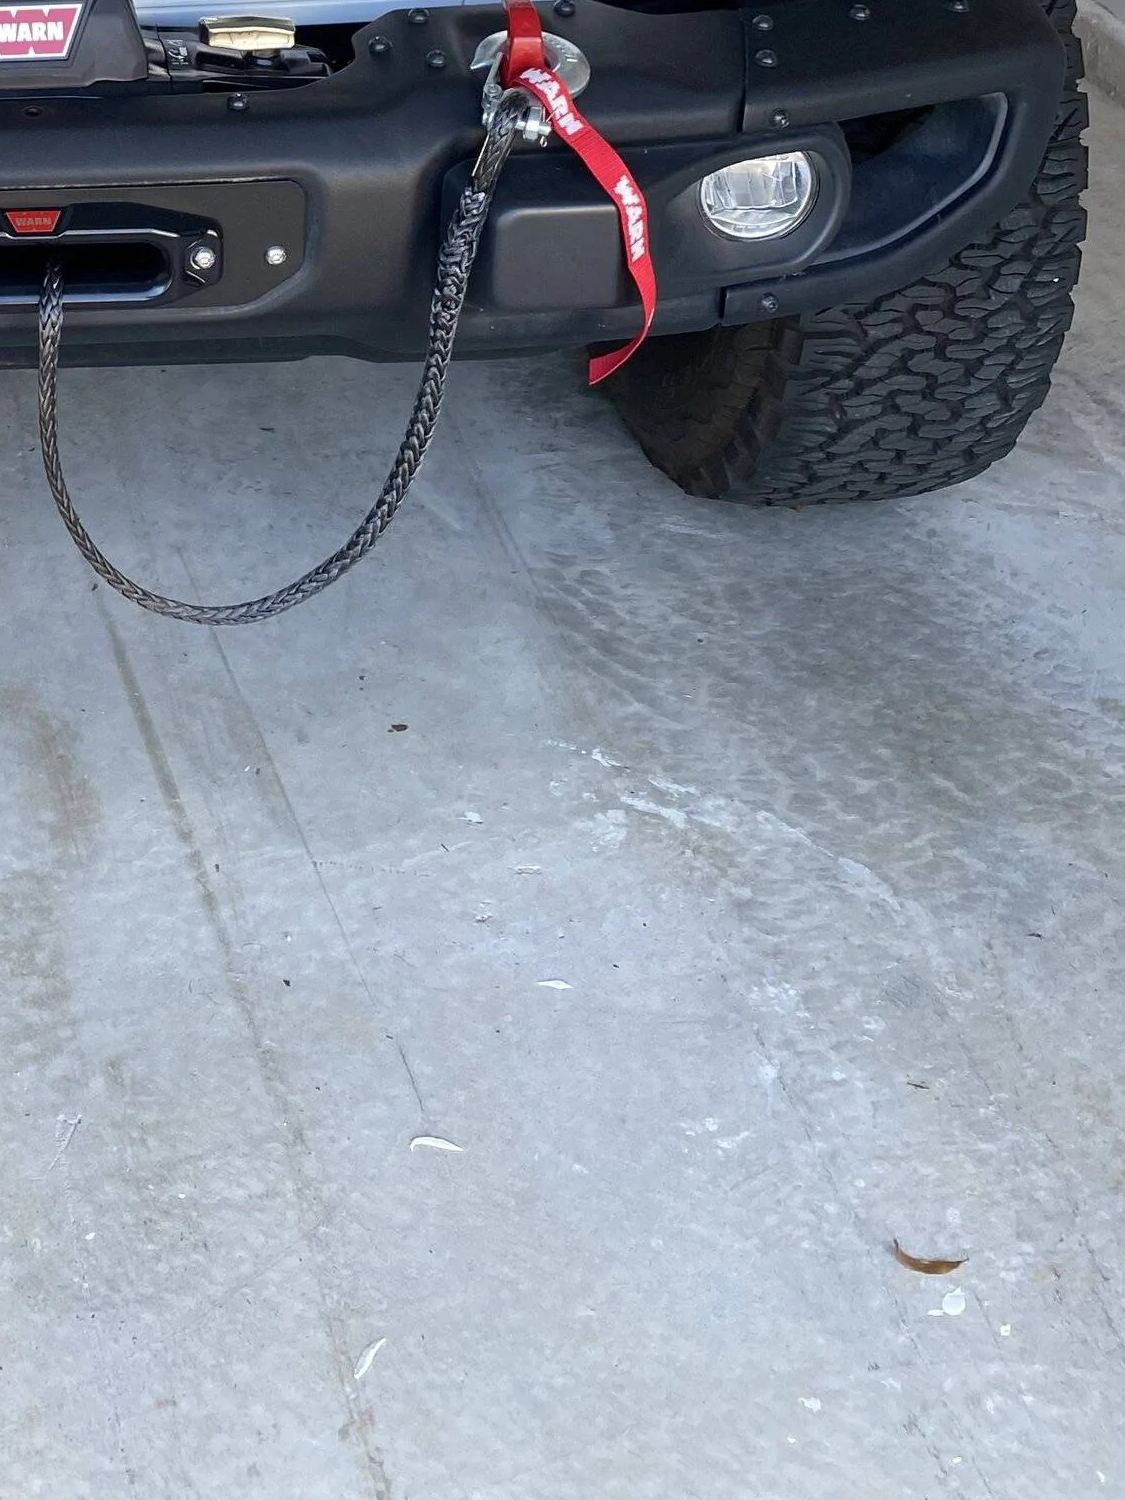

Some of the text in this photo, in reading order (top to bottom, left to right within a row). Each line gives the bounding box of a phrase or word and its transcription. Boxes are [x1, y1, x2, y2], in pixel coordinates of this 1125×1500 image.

[520, 68, 584, 135] WARN
[15, 217, 53, 226] WARN
[613, 175, 645, 262] WARN
